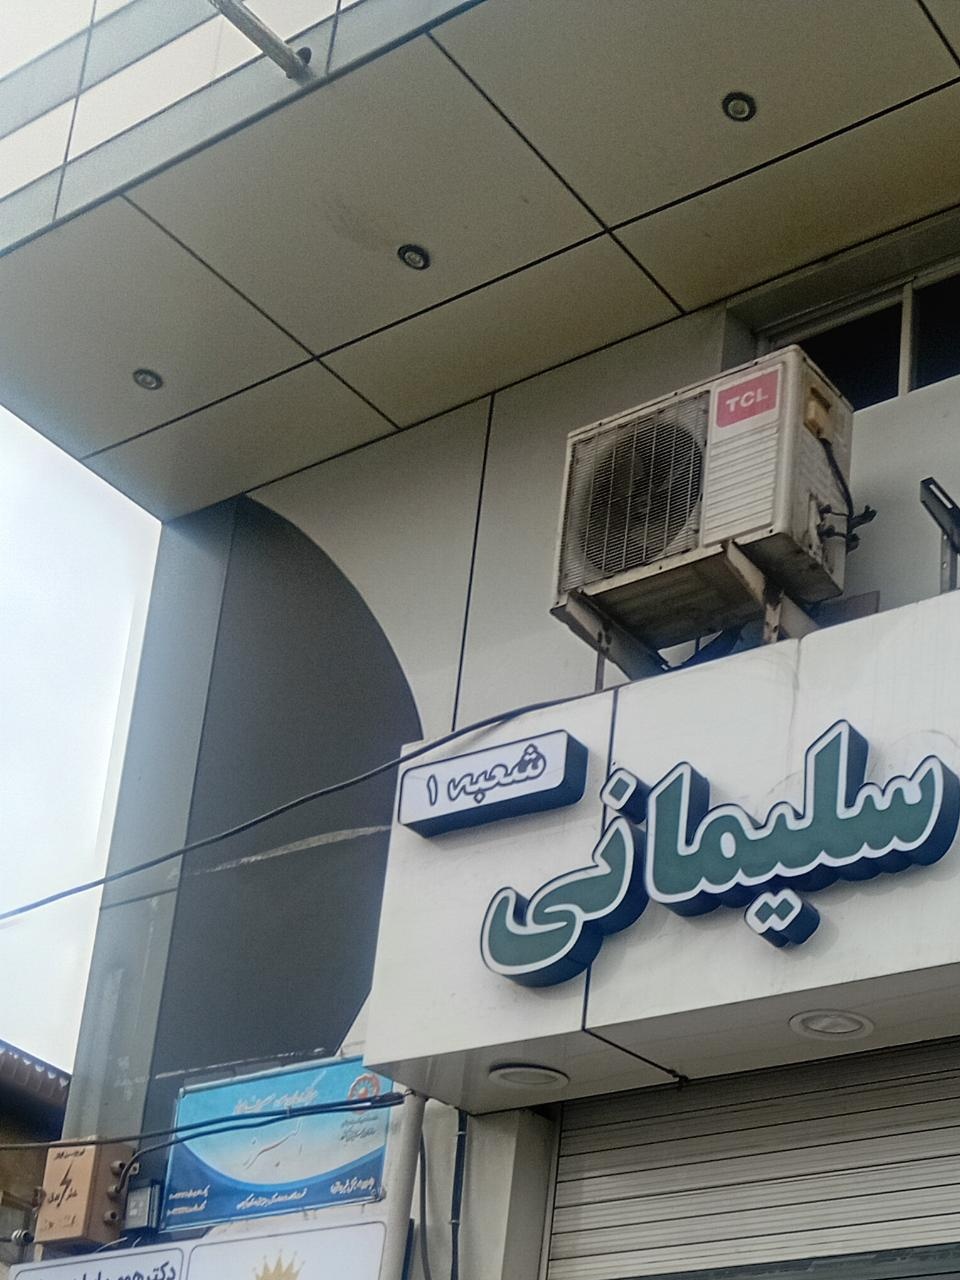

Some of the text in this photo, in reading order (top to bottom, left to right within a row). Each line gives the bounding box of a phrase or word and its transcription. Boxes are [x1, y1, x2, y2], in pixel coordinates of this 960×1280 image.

[726, 388, 769, 412] TCL
[447, 743, 547, 804] شعبه
[482, 721, 950, 980] سلیمانی
